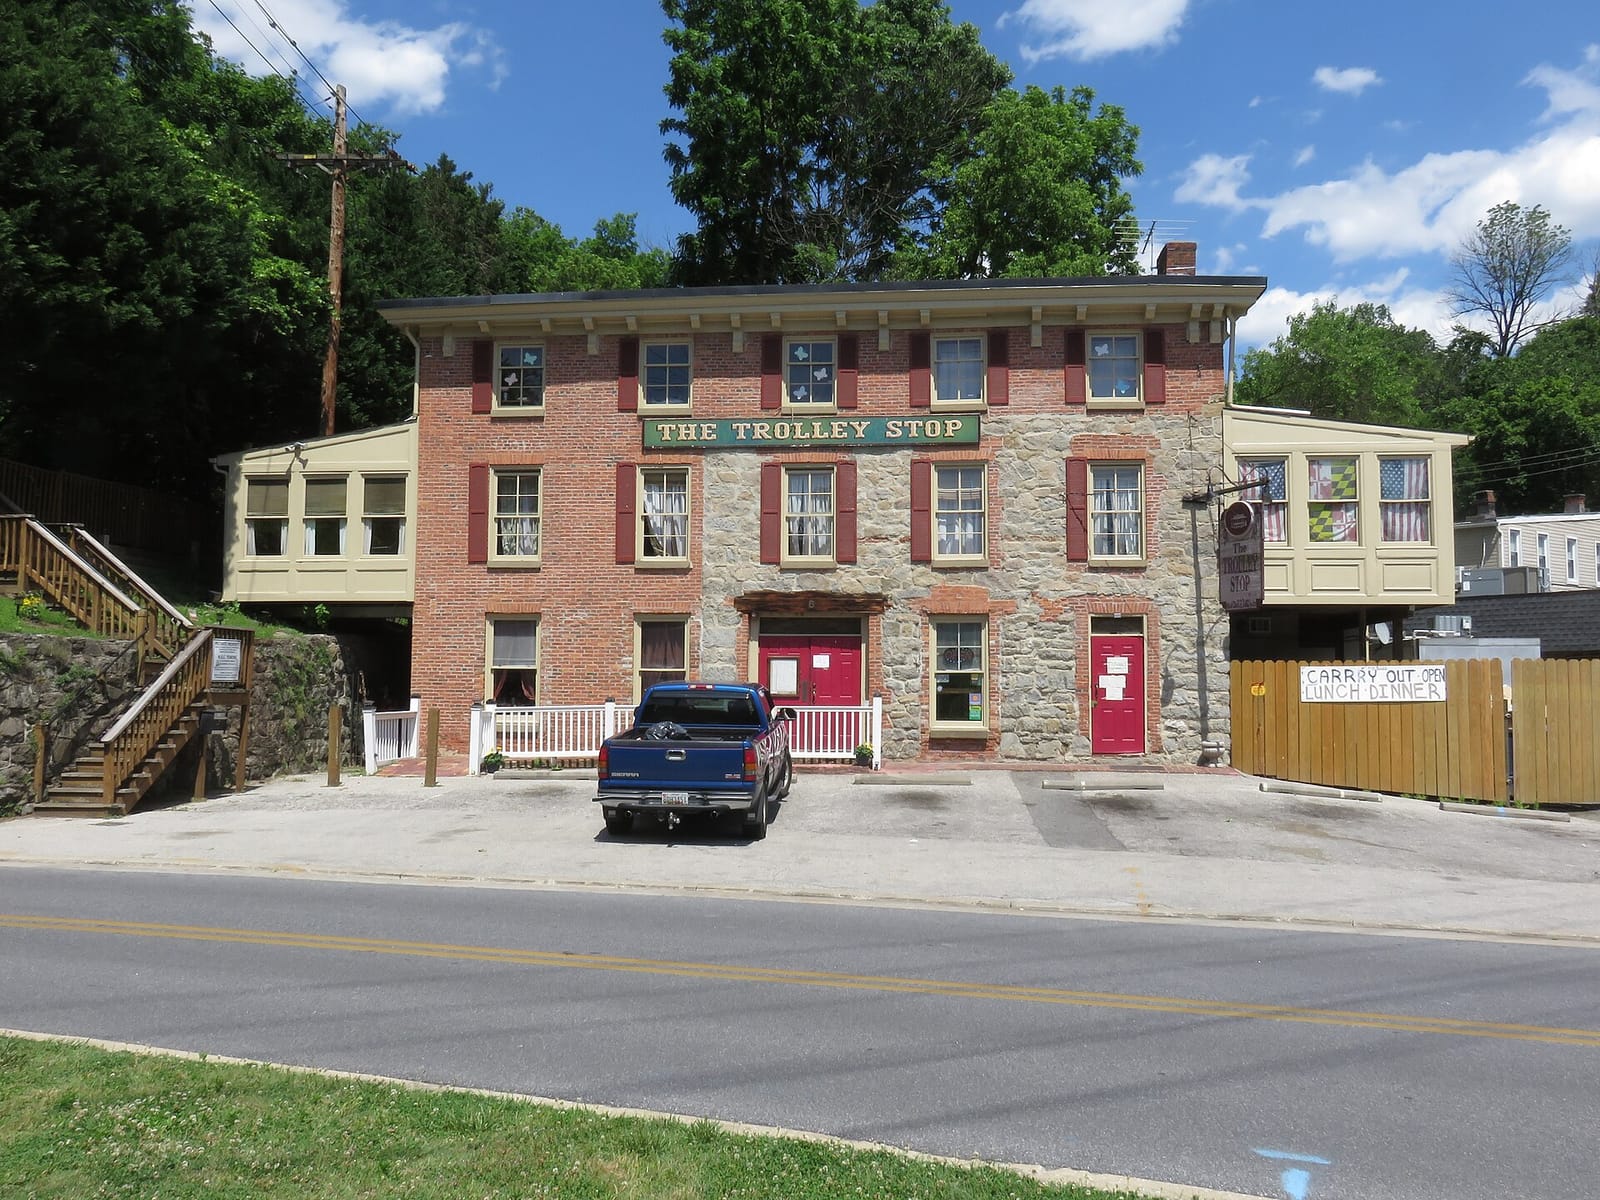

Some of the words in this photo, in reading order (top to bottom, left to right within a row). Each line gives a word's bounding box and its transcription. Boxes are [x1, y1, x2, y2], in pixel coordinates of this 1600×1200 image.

[657, 423, 717, 441] THE
[731, 421, 870, 441] TROLLEY
[885, 419, 963, 438] STOP
[1233, 543, 1247, 554] The
[1230, 575, 1250, 592] STOP
[1386, 669, 1416, 683] OUT
[1421, 668, 1446, 683] OPEN
[1305, 684, 1360, 700] LUNCH
[1369, 683, 1441, 700] DINNER
